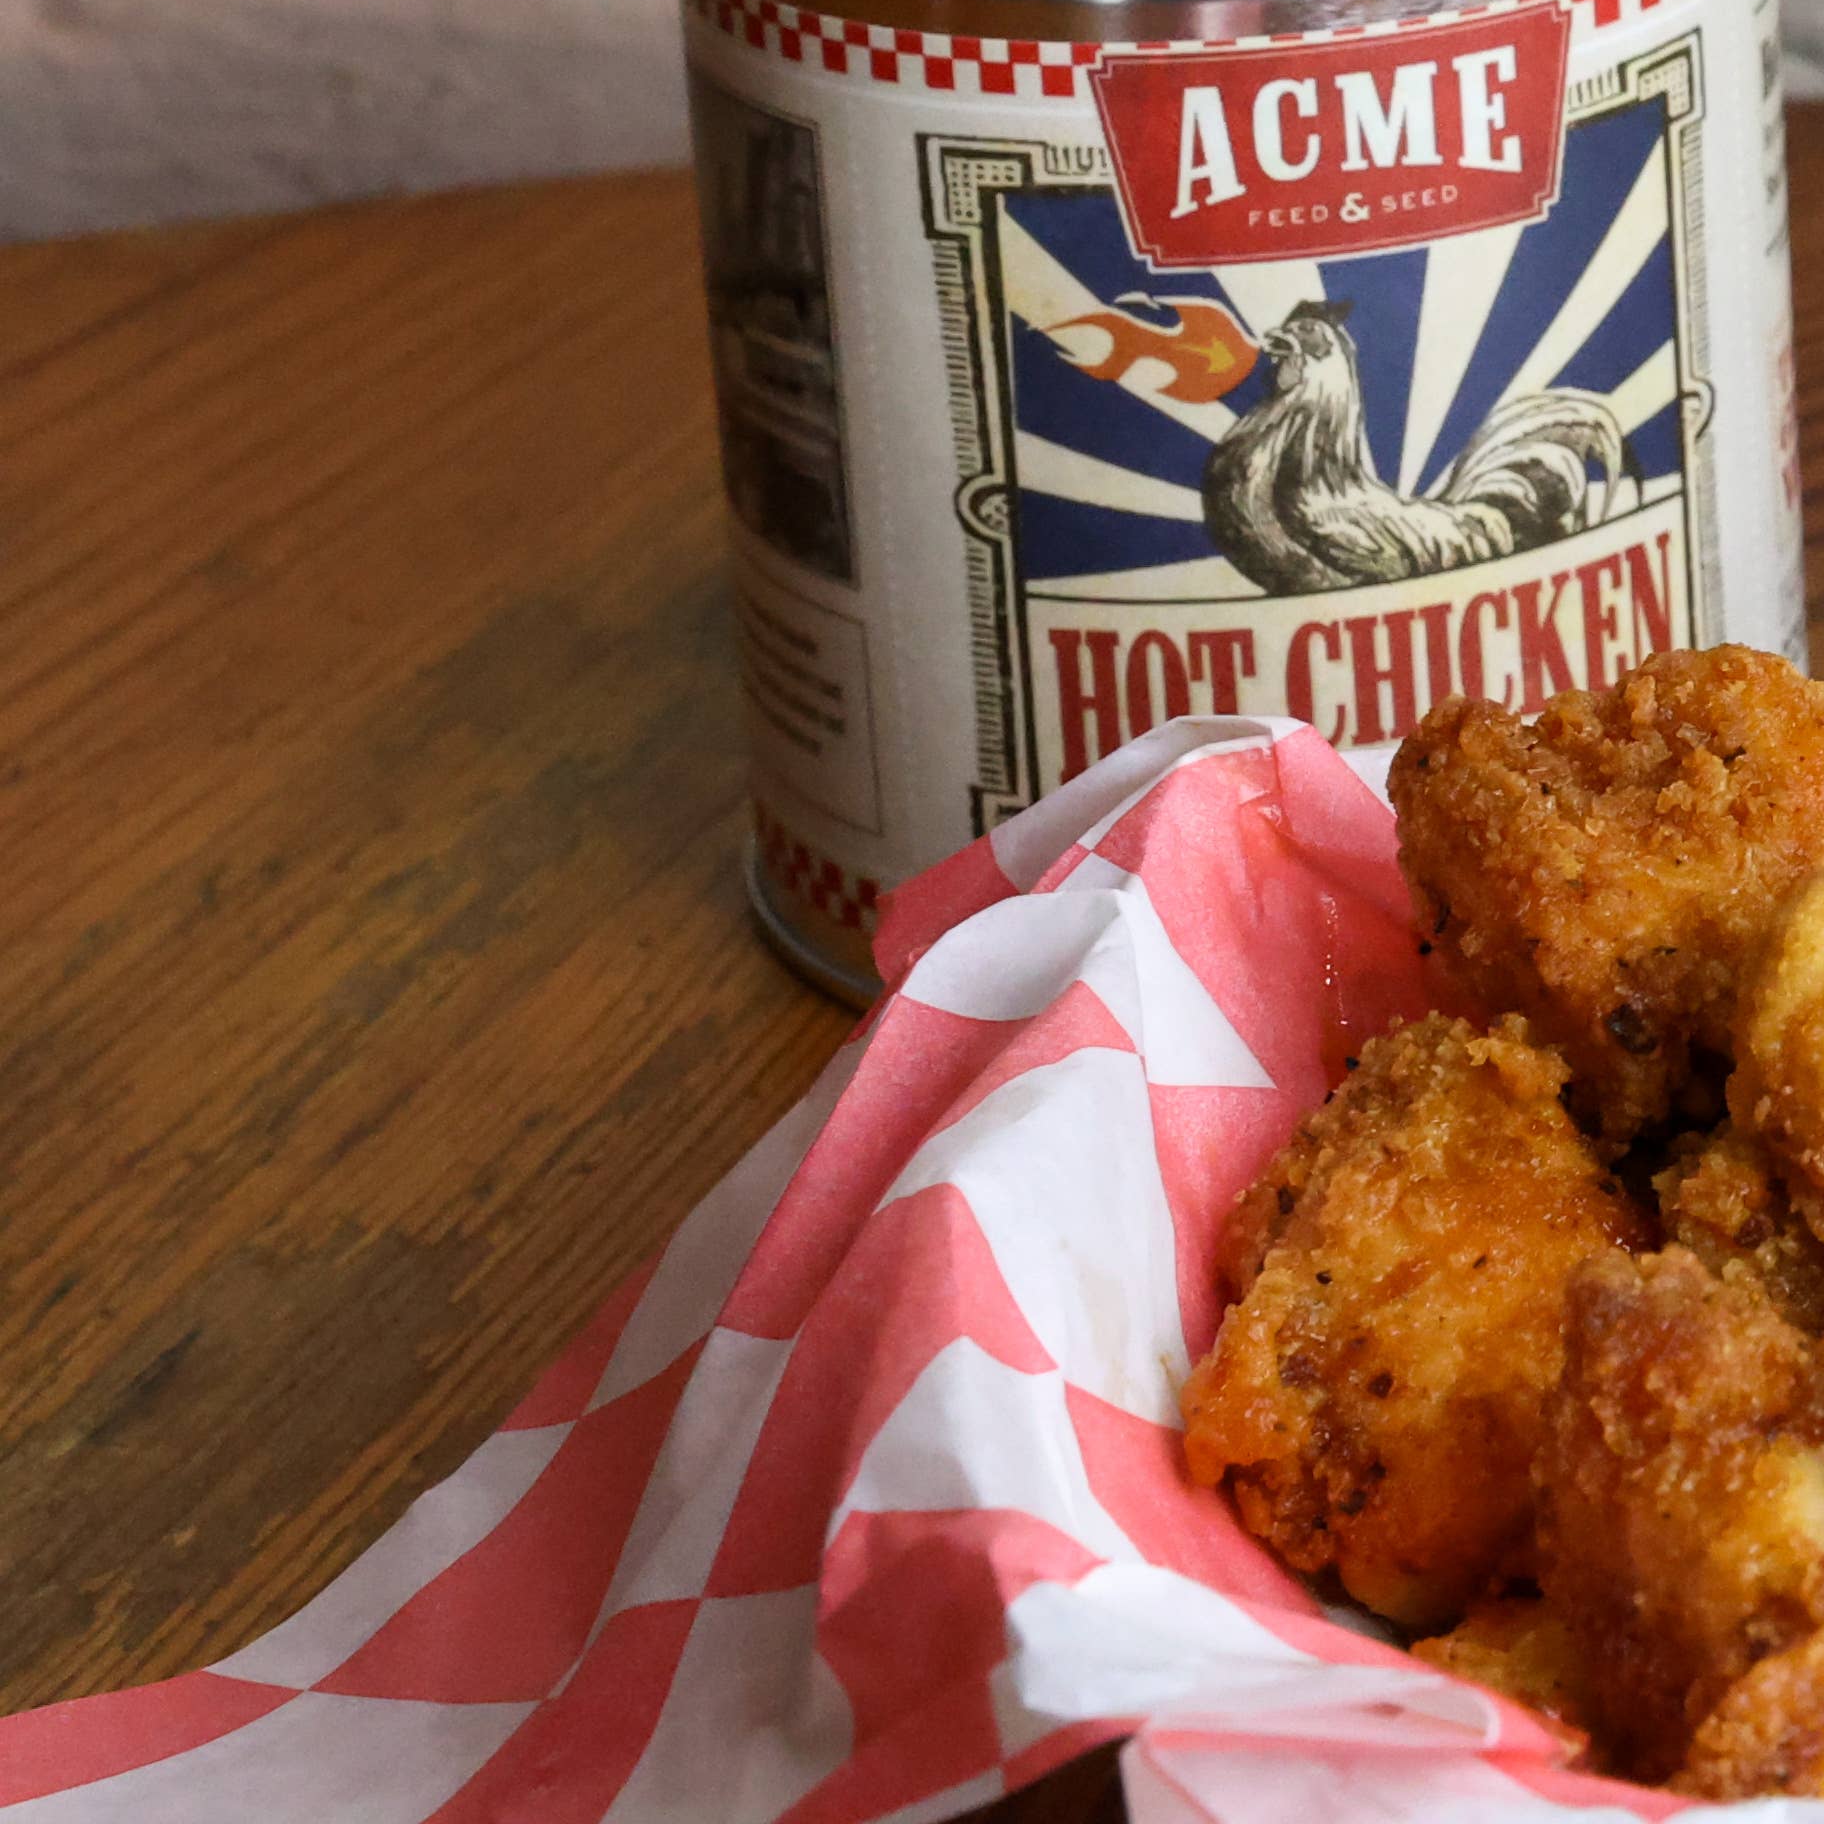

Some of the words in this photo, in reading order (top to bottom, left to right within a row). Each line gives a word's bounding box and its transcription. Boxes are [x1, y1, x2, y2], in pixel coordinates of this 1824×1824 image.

[1170, 44, 1523, 219] ACME
[1247, 204, 1330, 228] FEED
[1338, 192, 1371, 223] &
[1381, 184, 1459, 213] SEED
[1048, 628, 1256, 782] HOT
[1285, 529, 1673, 746] CHICKEN
